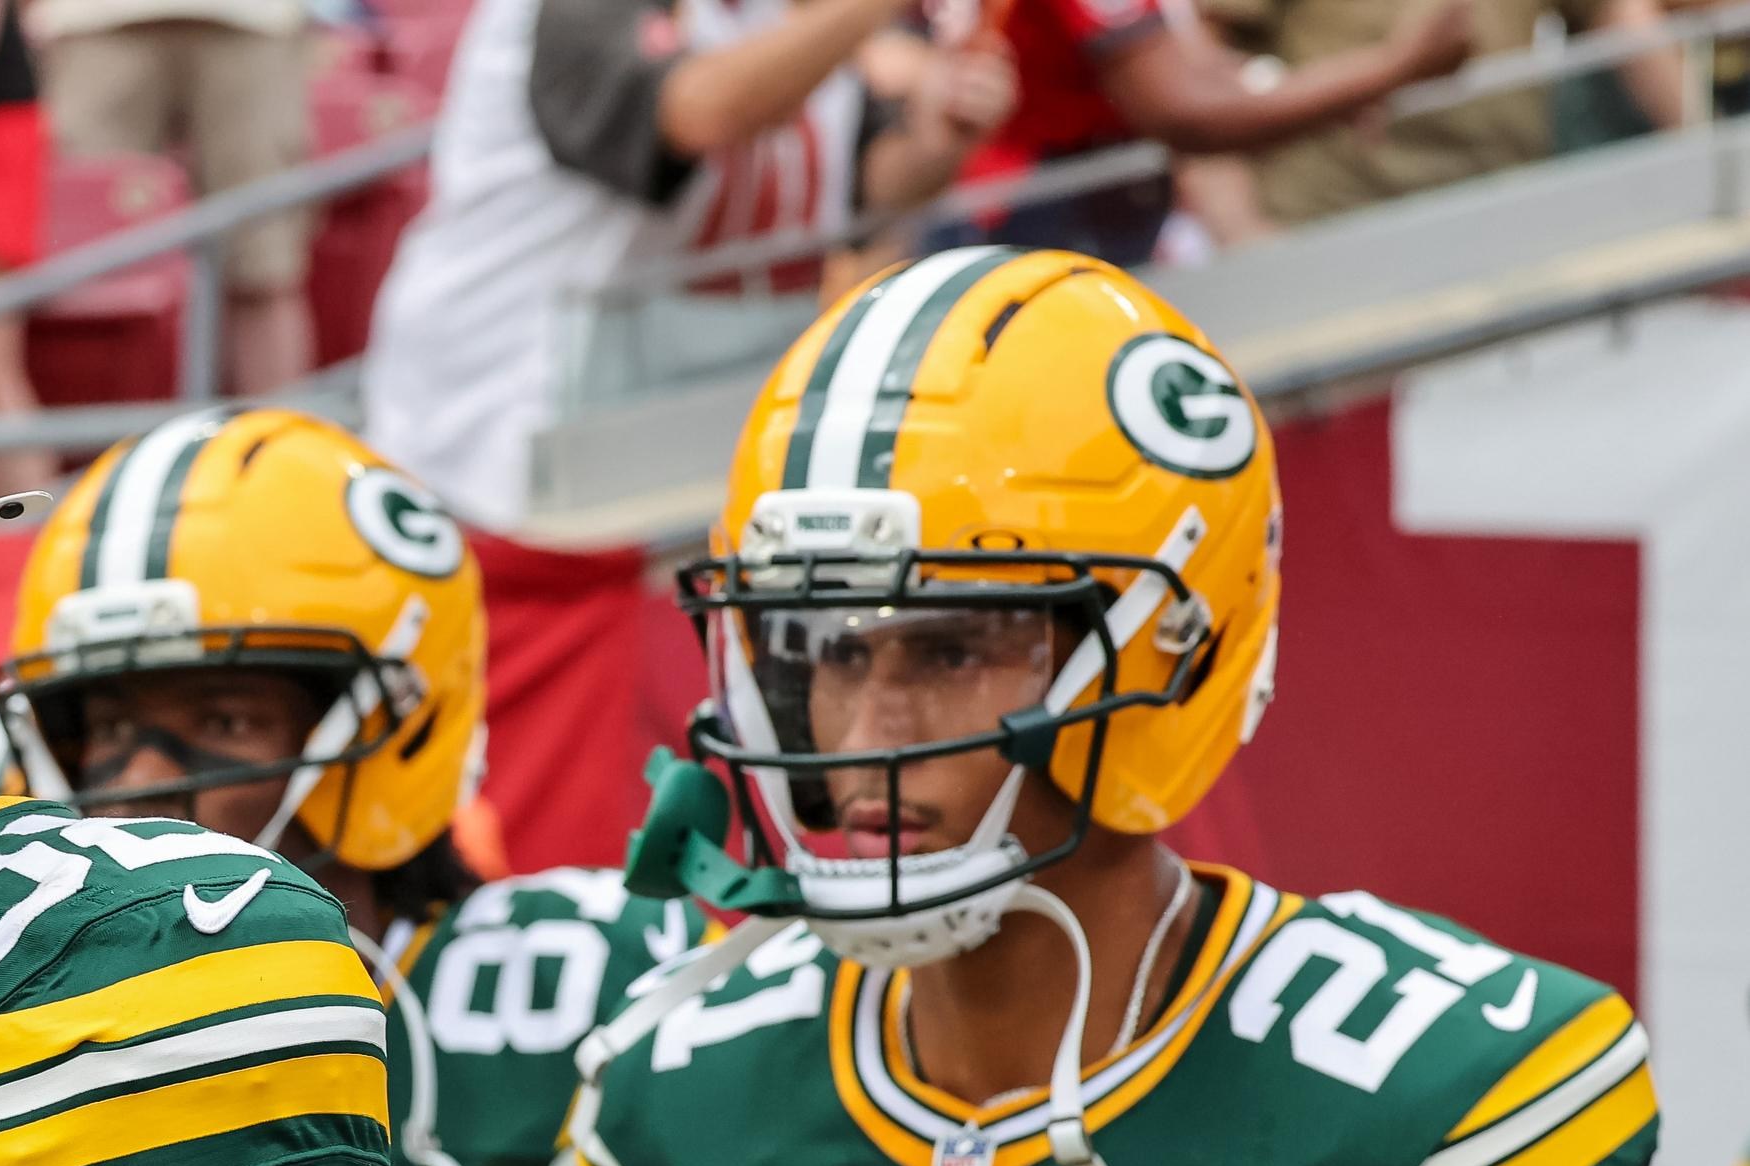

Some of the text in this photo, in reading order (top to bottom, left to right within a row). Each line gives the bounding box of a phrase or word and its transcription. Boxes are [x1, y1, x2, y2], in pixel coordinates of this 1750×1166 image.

[1116, 337, 1255, 471] G
[350, 469, 463, 575] G
[1228, 889, 1514, 1094] 21
